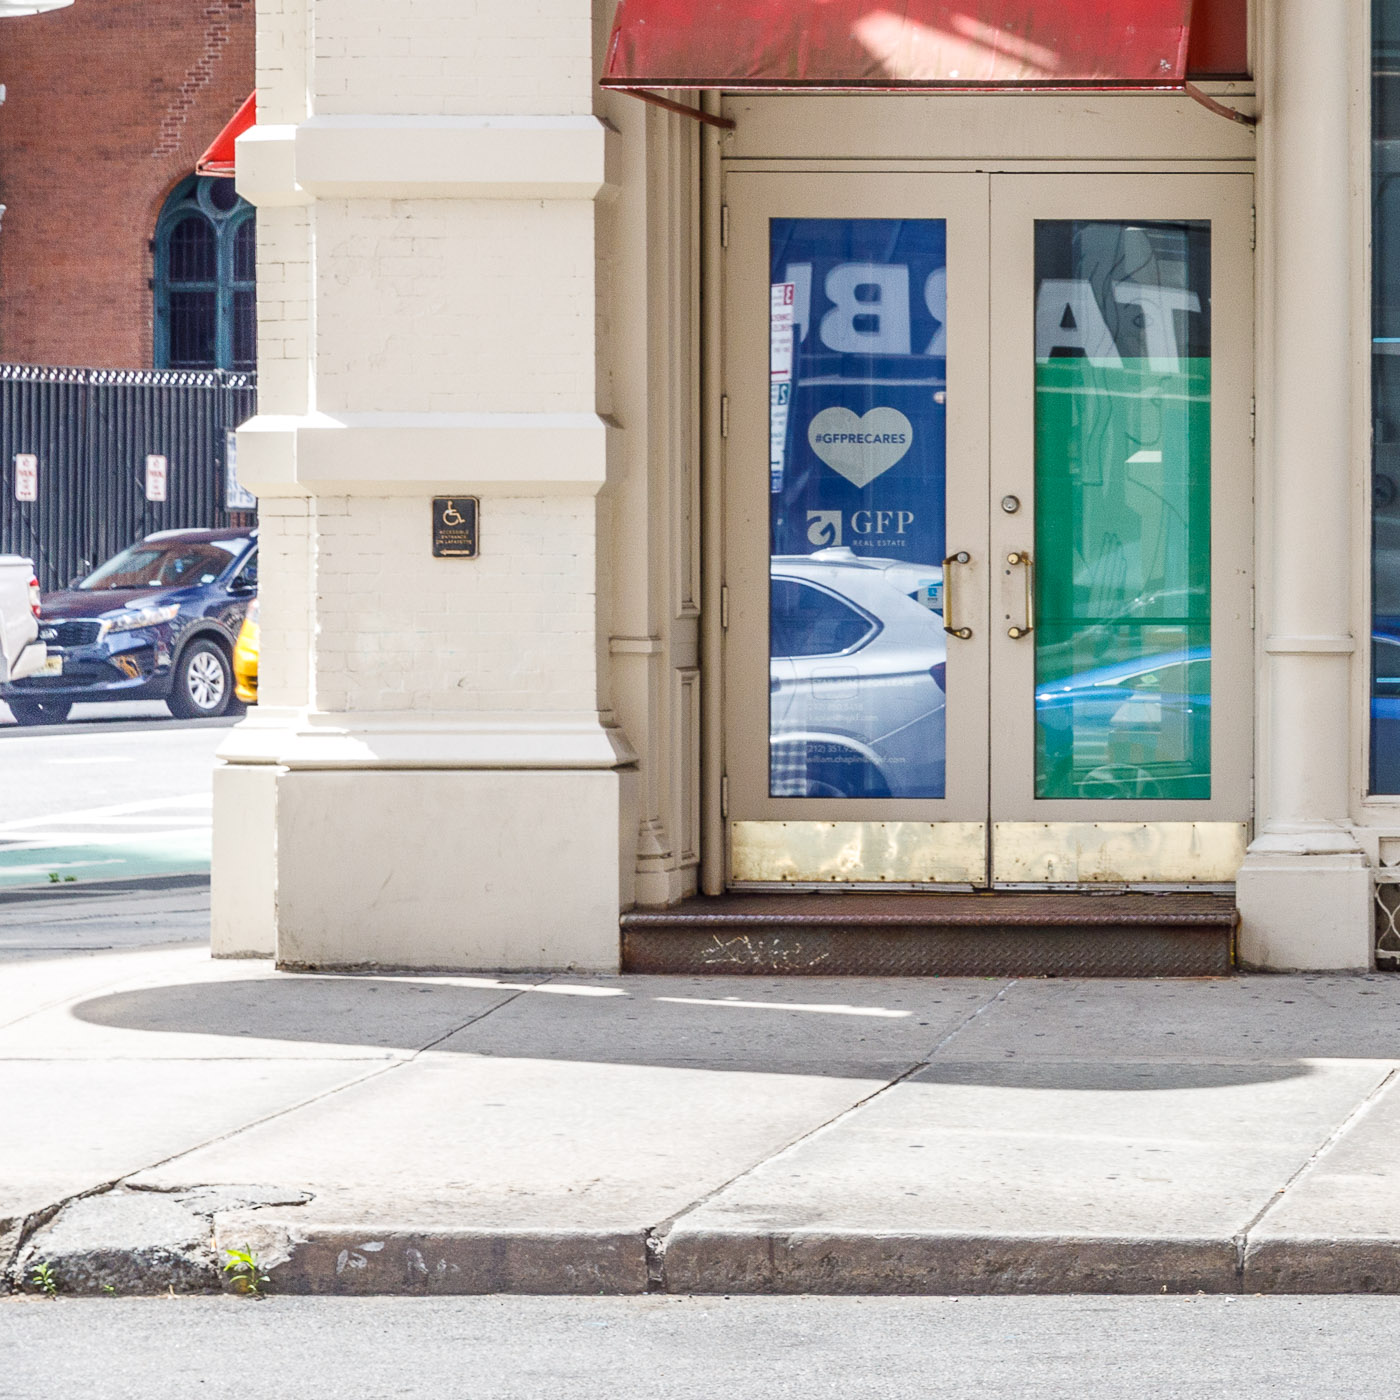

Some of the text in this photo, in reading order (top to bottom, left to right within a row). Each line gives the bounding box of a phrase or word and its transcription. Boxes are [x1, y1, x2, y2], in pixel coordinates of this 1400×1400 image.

[815, 432, 906, 445] #GFPRECARES
[851, 511, 914, 535] GFP
[853, 539, 906, 548] REAL ESTATE
